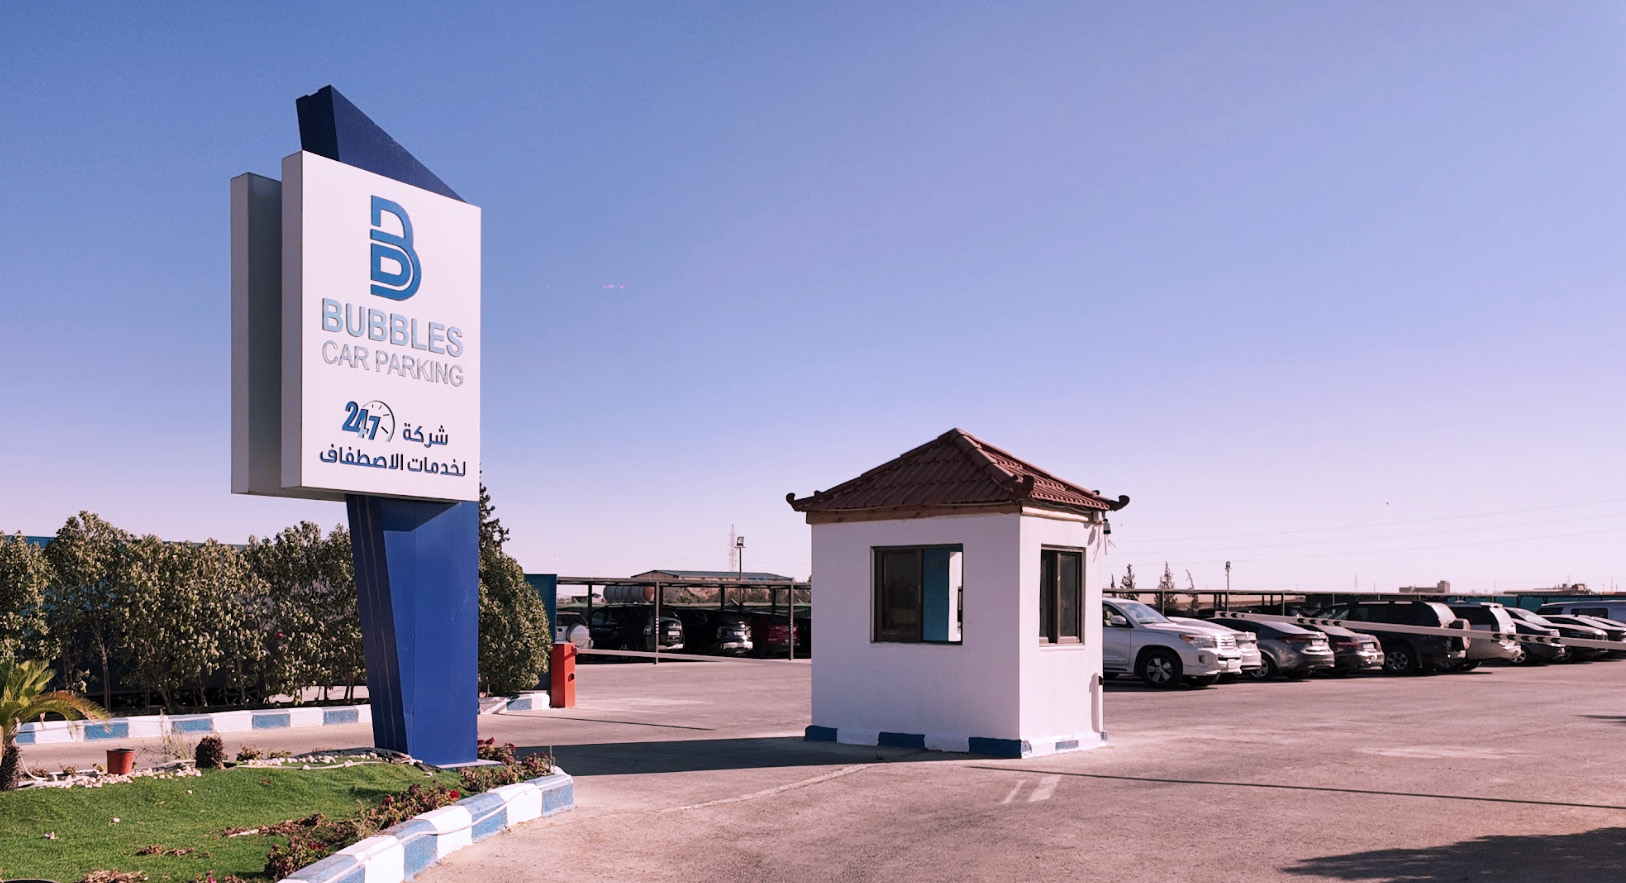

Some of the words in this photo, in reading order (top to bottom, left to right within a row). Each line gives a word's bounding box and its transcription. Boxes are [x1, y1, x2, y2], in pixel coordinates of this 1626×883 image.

[322, 298, 464, 357] BUBBLES
[322, 340, 370, 370] CAR
[376, 350, 464, 387] PARKING
[402, 423, 448, 448] شركة
[319, 443, 404, 471] الاصطفاف
[407, 457, 466, 477] لخدمات
